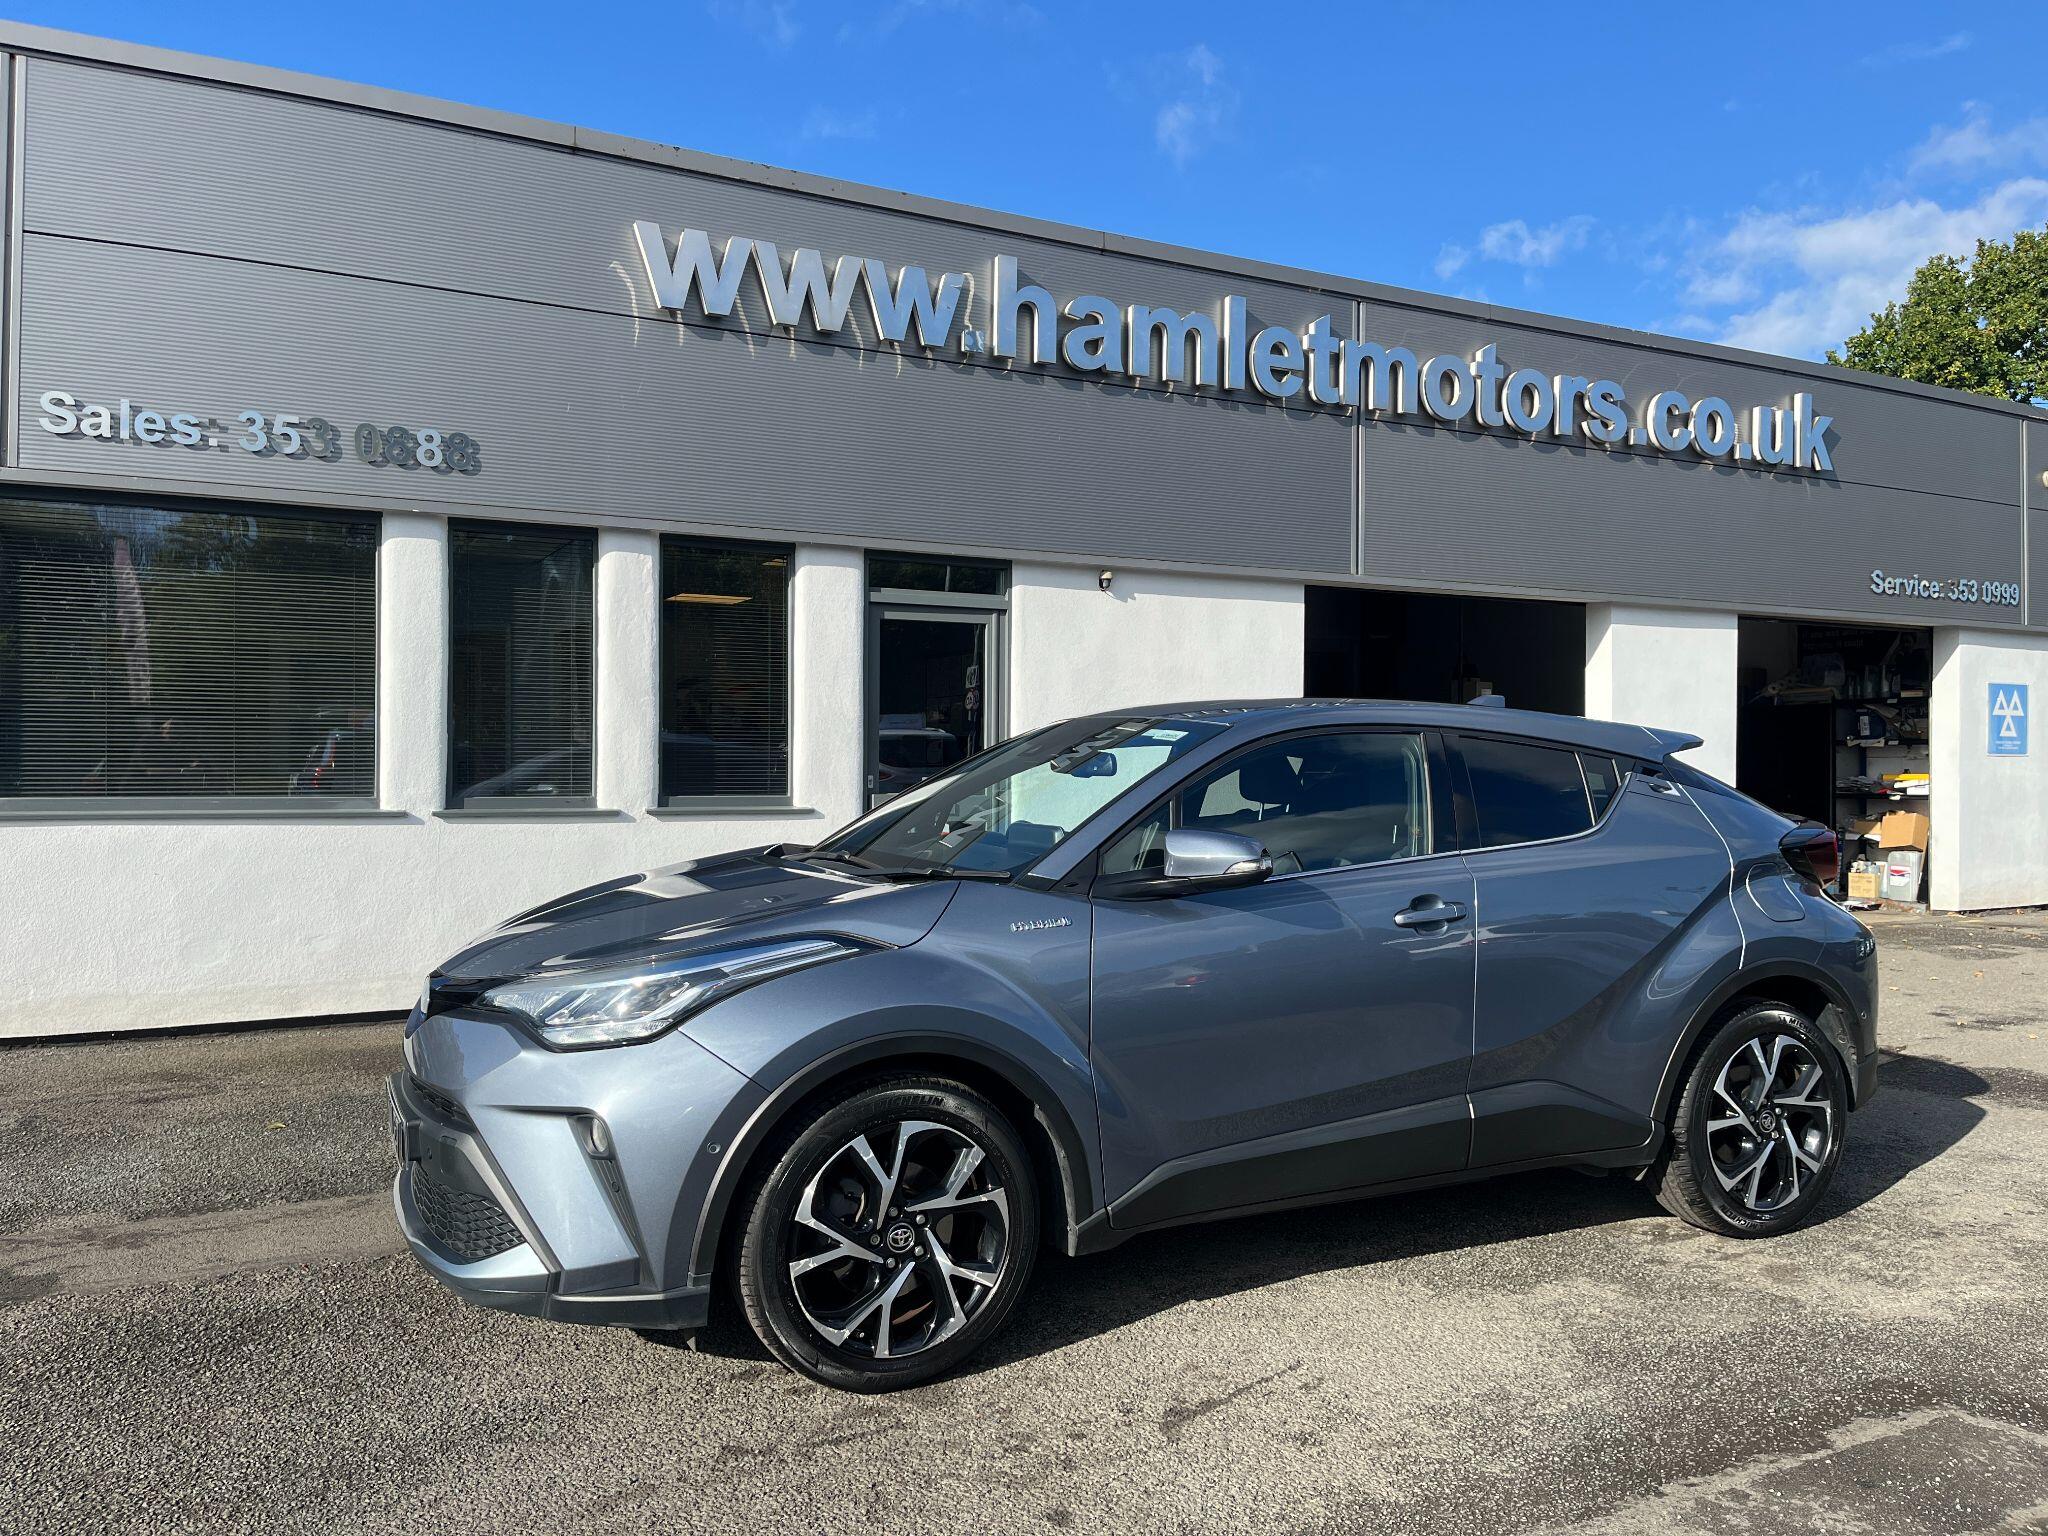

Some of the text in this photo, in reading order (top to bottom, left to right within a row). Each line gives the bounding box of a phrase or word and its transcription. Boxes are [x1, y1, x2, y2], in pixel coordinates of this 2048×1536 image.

[633, 220, 1834, 471] www.hamletmotors.co.uk
[38, 390, 475, 471] Sales: 353 0888
[1870, 569, 1945, 599] Service:
[1981, 580, 2020, 606] 0999
